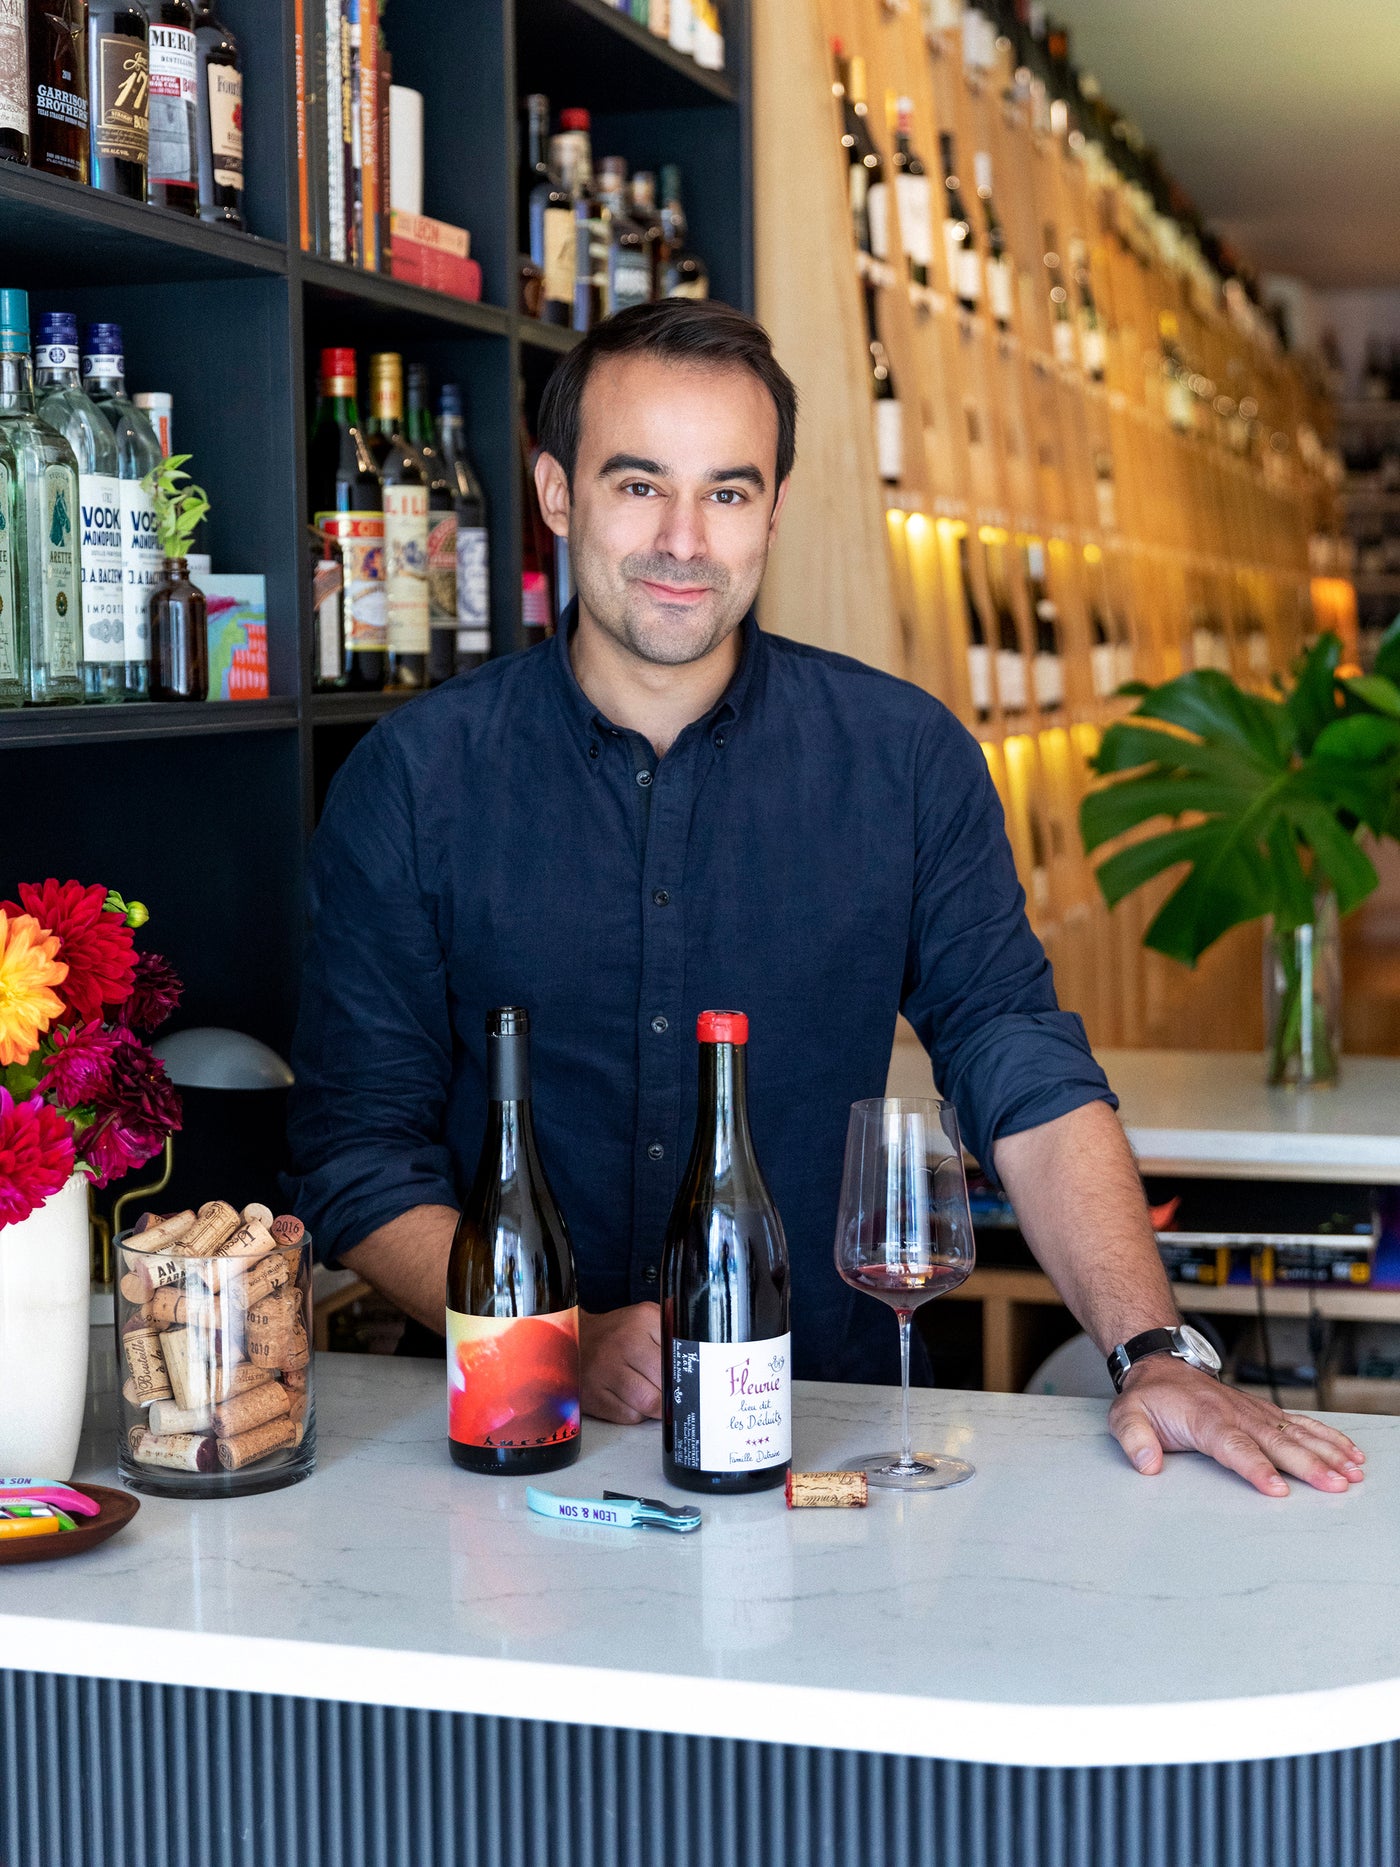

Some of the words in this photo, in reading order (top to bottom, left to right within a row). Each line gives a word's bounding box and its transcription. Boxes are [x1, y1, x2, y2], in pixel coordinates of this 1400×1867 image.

[37, 84, 87, 110] GARRISON
[37, 95, 88, 122] BROTHERS
[50, 551, 72, 564] ARETTE
[274, 1220, 300, 1233] 2016
[247, 1311, 268, 1325] 2010
[251, 1342, 270, 1356] 2010
[136, 1338, 154, 1392] Bouteille
[726, 1358, 780, 1397] Fleurie
[738, 1400, 757, 1412] lieu
[760, 1399, 772, 1411] dit
[728, 1416, 744, 1431] les
[747, 1413, 783, 1430] Déduits
[729, 1451, 753, 1465] Famille
[9, 1477, 32, 1485] SON
[559, 1504, 578, 1517] SON
[582, 1507, 590, 1519] &
[593, 1511, 617, 1523] LEON
